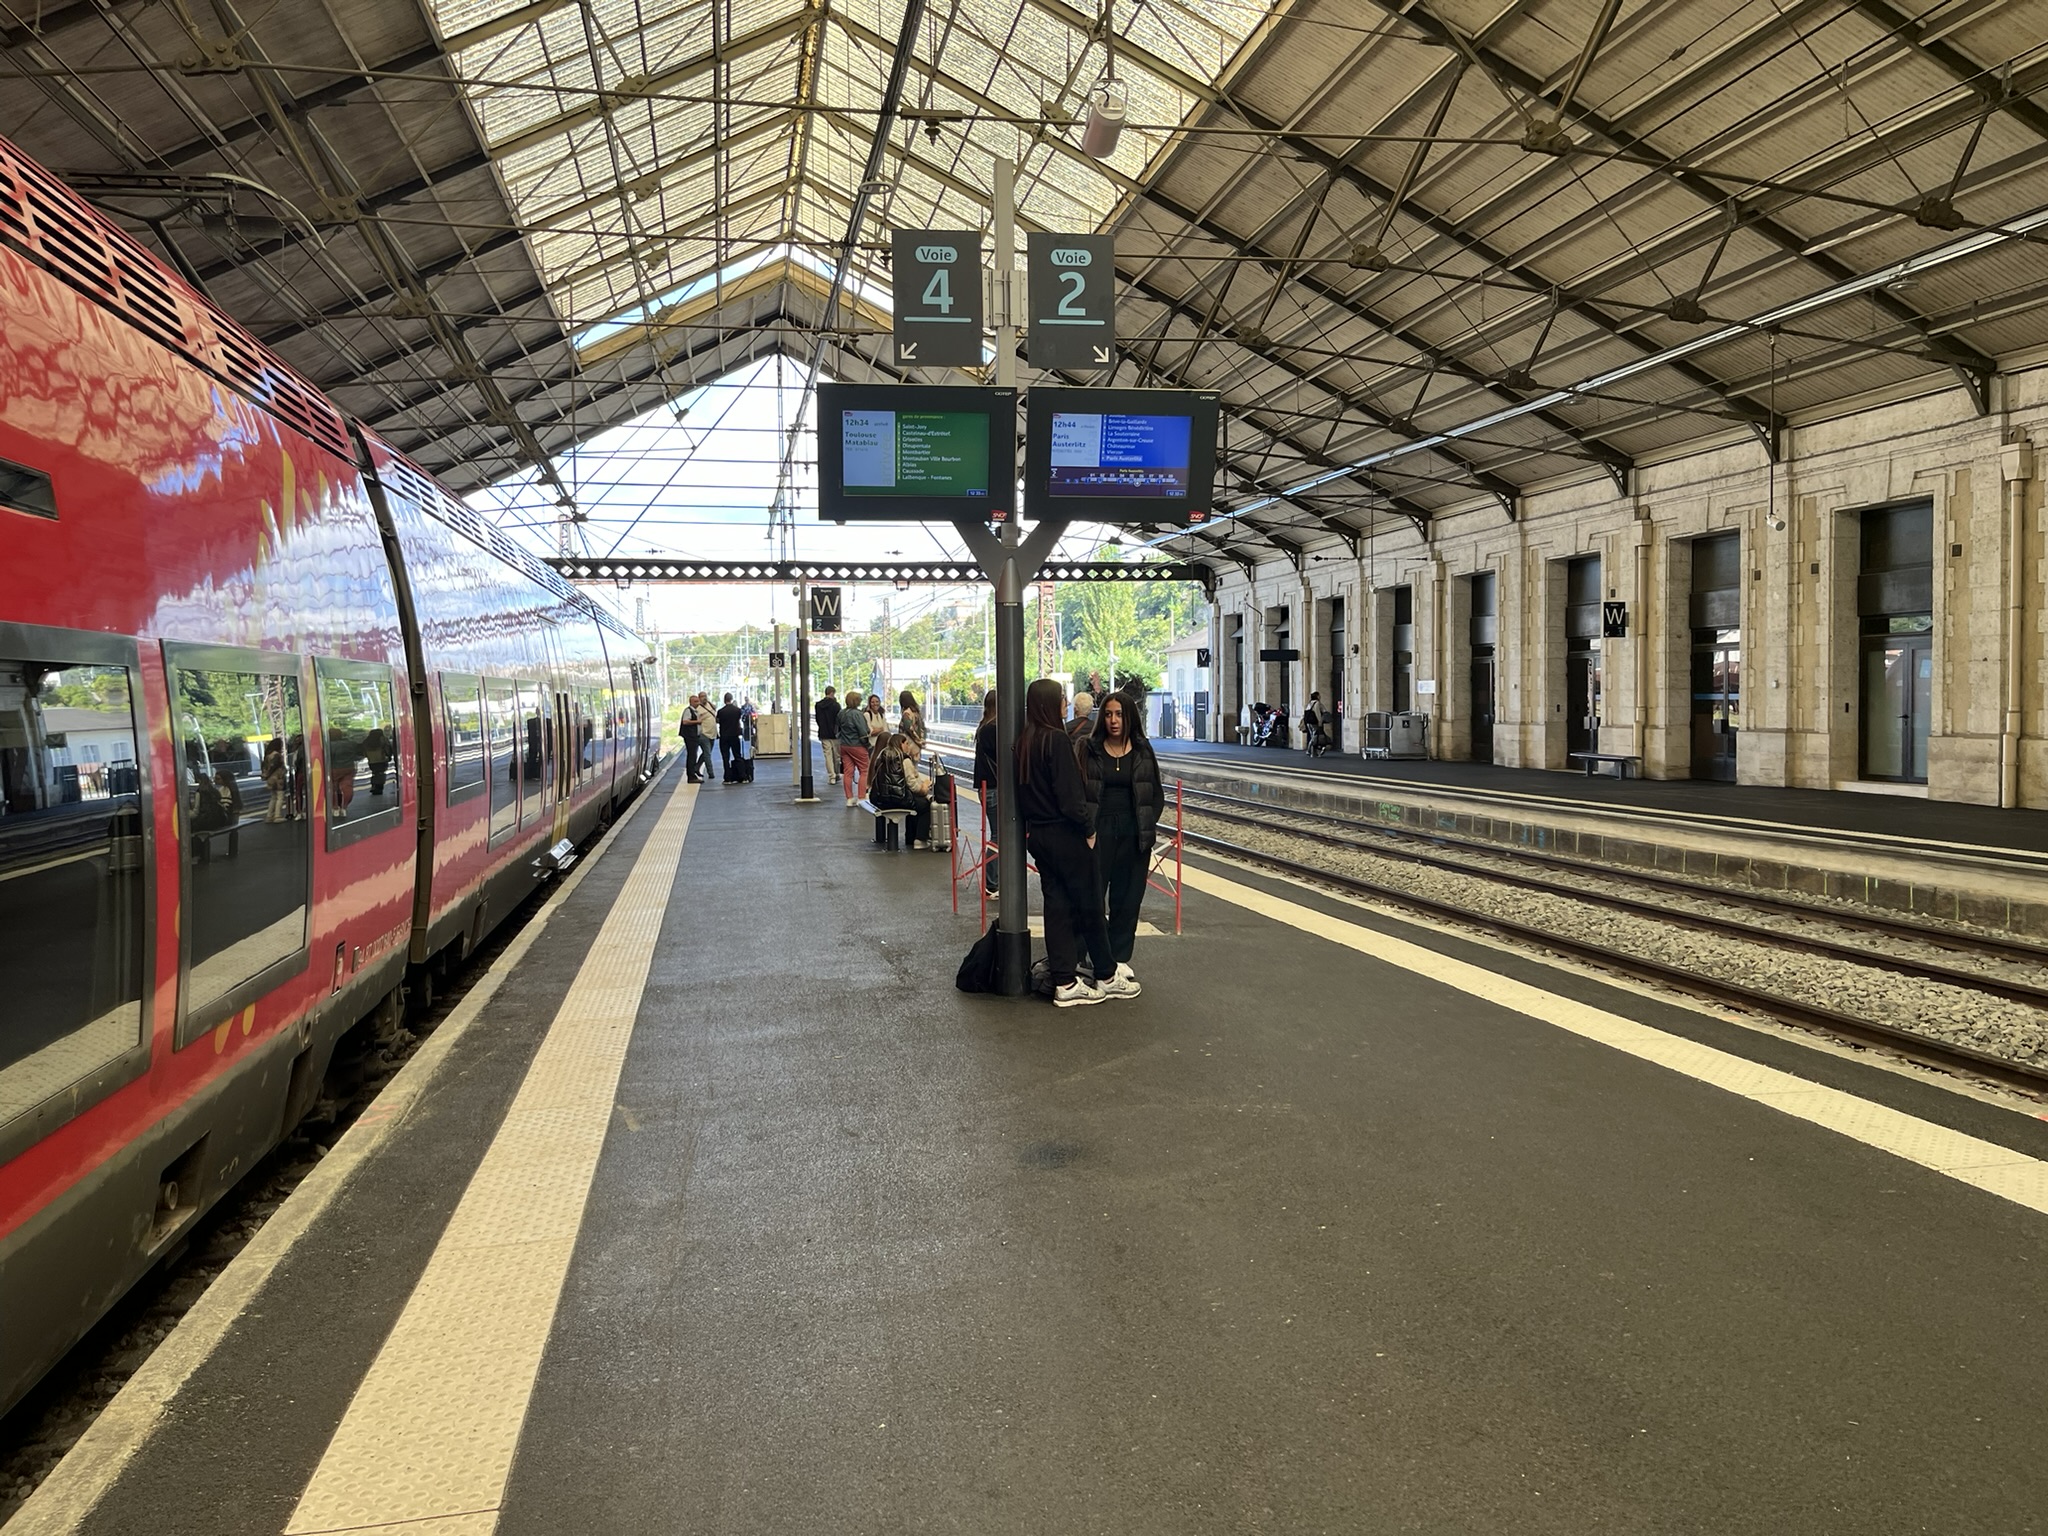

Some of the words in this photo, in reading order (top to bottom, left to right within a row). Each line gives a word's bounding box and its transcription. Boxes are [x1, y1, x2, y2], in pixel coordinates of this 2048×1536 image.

[920, 248, 952, 262] Voie
[1056, 251, 1086, 265] Voie
[922, 269, 954, 314] 4
[1058, 271, 1086, 316] 2
[813, 595, 840, 616] W
[1605, 608, 1624, 625] W
[772, 658, 783, 667] 90
[1199, 652, 1207, 661] V
